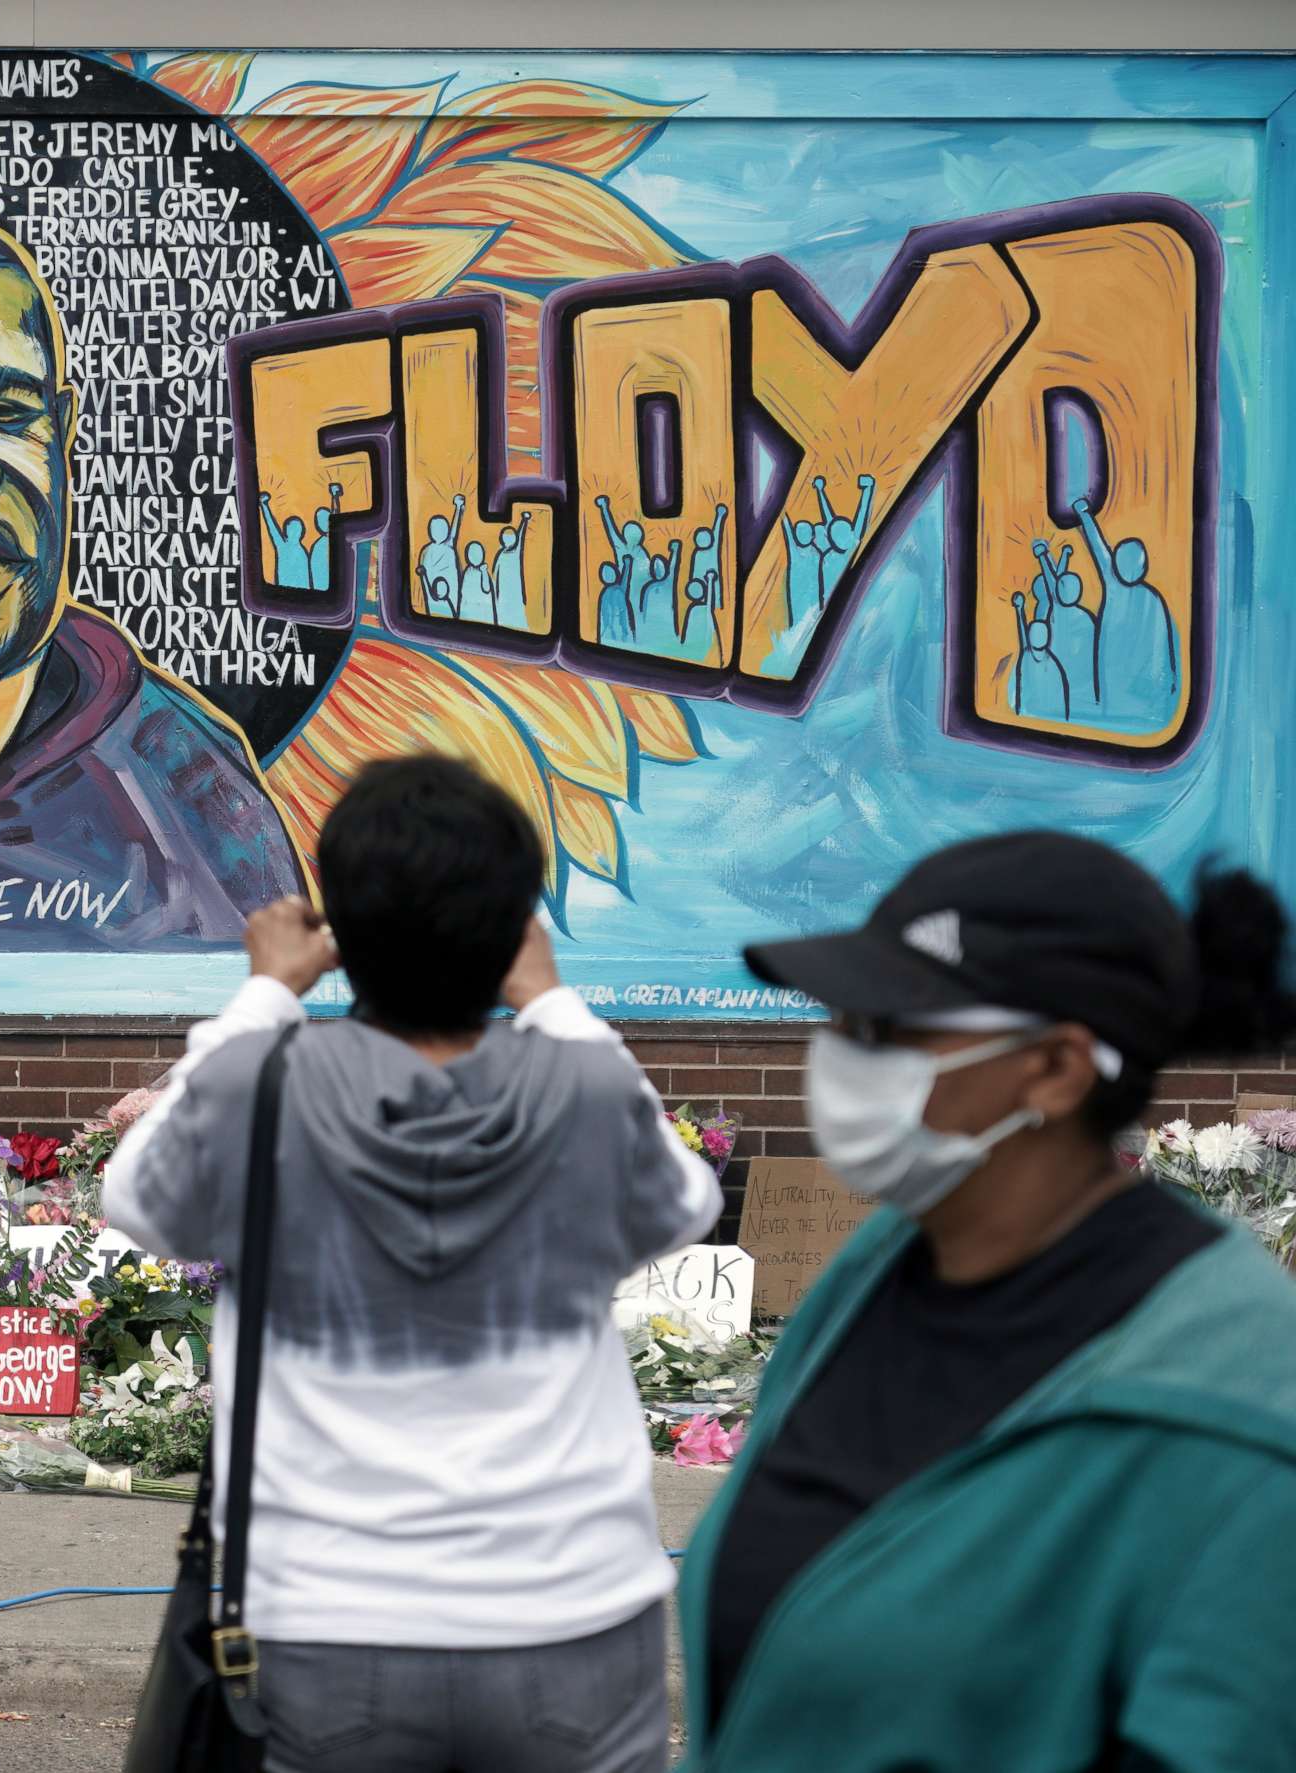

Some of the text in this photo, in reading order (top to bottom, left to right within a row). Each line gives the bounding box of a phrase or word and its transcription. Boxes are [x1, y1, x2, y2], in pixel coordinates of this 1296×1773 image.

[48, 122, 178, 158] JEREMY
[83, 156, 203, 188] CASTILE
[28, 187, 152, 218] FREDDIE
[159, 187, 239, 220] GREY
[7, 215, 271, 246] TERRANCE FRANKLIN
[35, 245, 335, 280] BREONNA TAYLOR AL
[52, 278, 336, 312] SHANTEL DAVIS WI
[58, 311, 185, 346] WALTER
[65, 346, 154, 380] REKIA
[164, 378, 223, 418] SMI
[74, 413, 184, 455] SHELLY
[70, 455, 182, 495] JAMAR
[248, 220, 1199, 750] FLOYD
[72, 496, 208, 534] TANISHA
[72, 532, 189, 568] TARIKA
[72, 566, 238, 607] ALTON STE
[114, 606, 302, 653] KORRYNGA
[157, 650, 315, 686] KATHRYN
[24, 878, 133, 928] NOW
[622, 984, 682, 1006] GRETA
